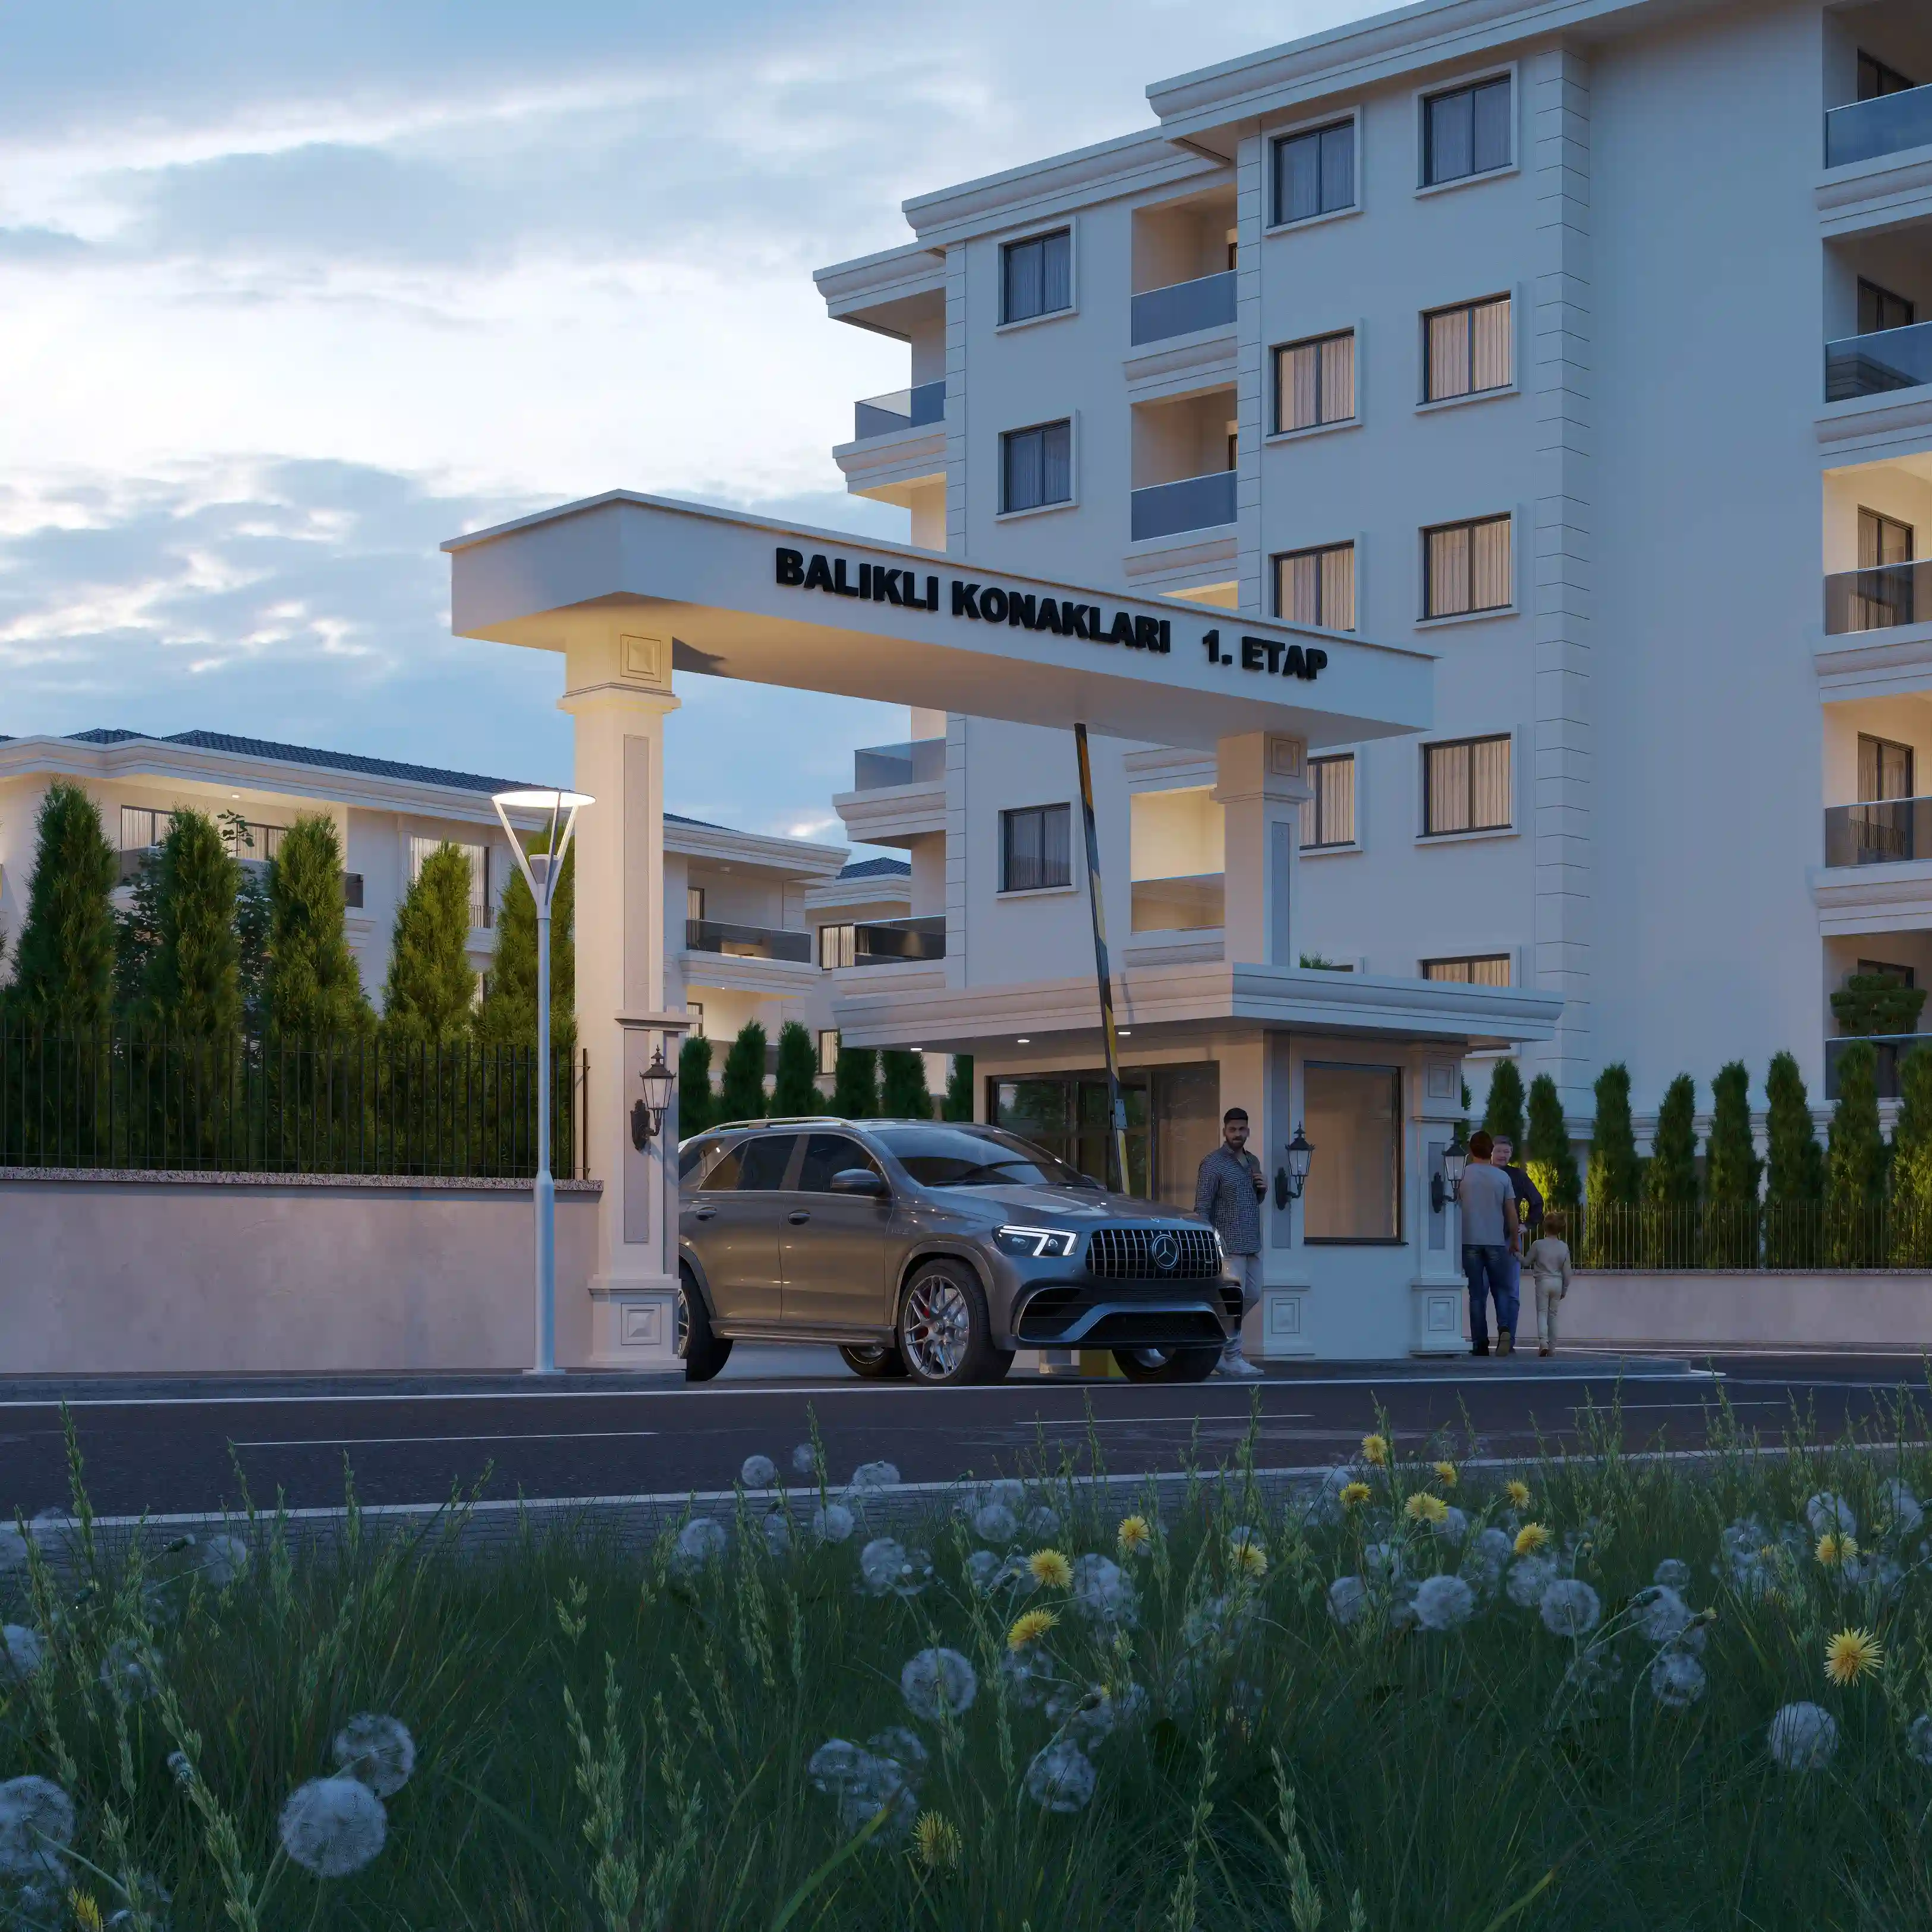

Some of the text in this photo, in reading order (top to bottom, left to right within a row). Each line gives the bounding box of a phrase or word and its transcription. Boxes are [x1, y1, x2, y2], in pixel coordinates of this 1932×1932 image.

[776, 547, 1327, 679] BALIKLI KONAKLARI 1. ETAP
